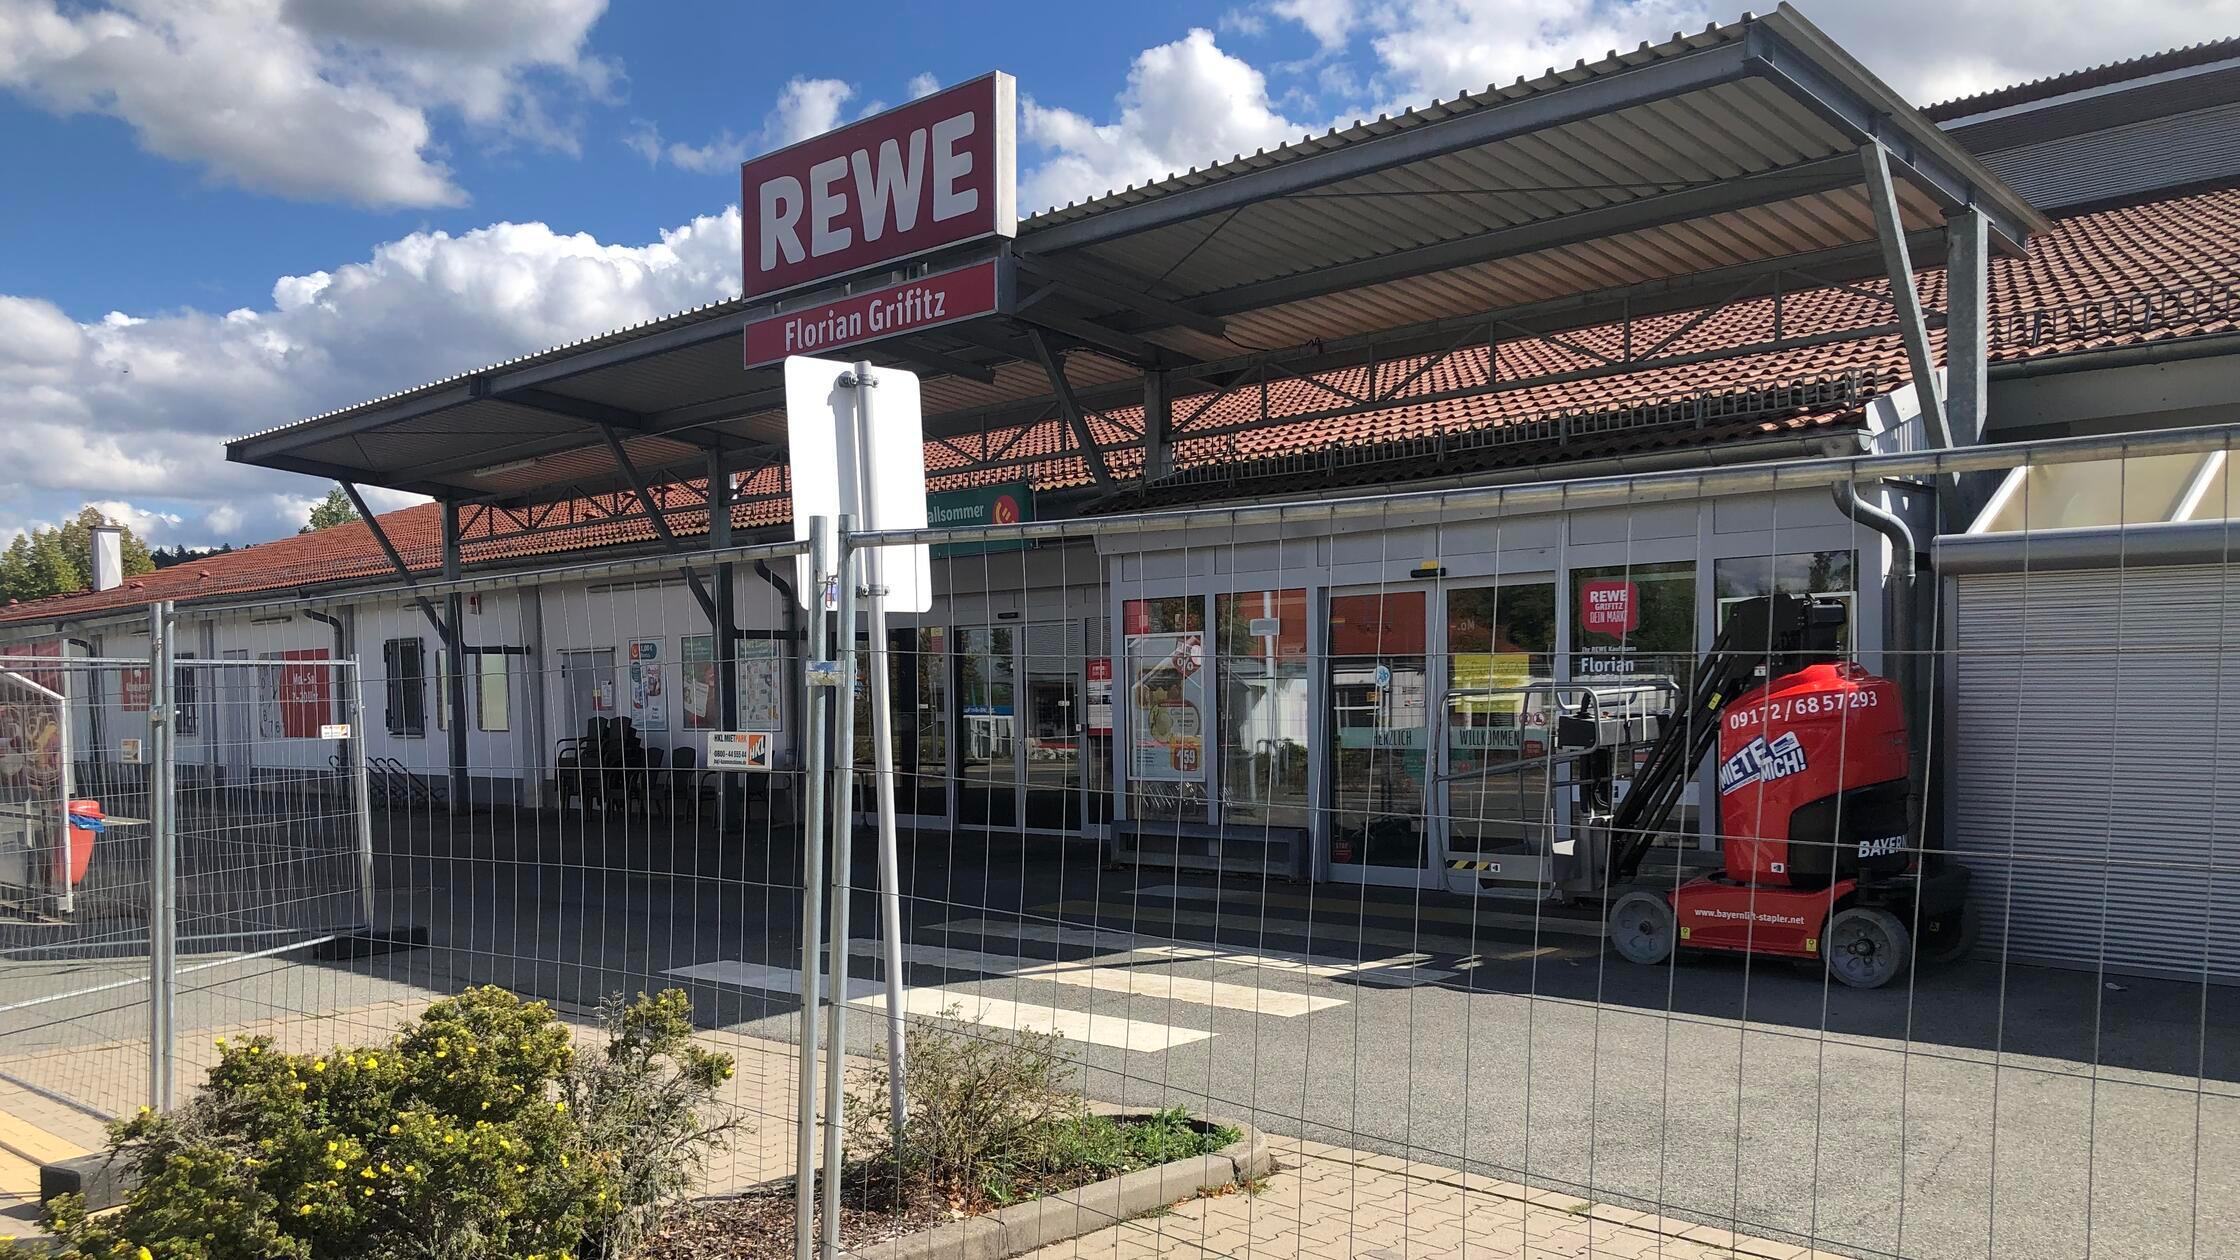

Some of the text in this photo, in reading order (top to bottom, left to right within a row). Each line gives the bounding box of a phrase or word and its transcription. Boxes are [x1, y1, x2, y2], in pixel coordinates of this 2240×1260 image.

[759, 111, 978, 272] REWE
[785, 287, 946, 351] Florian Grifitz
[928, 504, 984, 523] allsommer
[1590, 589, 1628, 602] REWE
[1594, 602, 1624, 611] GRIFITZ
[1606, 610, 1626, 622] MARK
[1581, 656, 1634, 672] Florian
[1730, 703, 1781, 729] 09172
[1460, 730, 1520, 746] WILLKOMMEN
[1719, 737, 1774, 789] MIETE
[1760, 747, 1807, 782] MICH!
